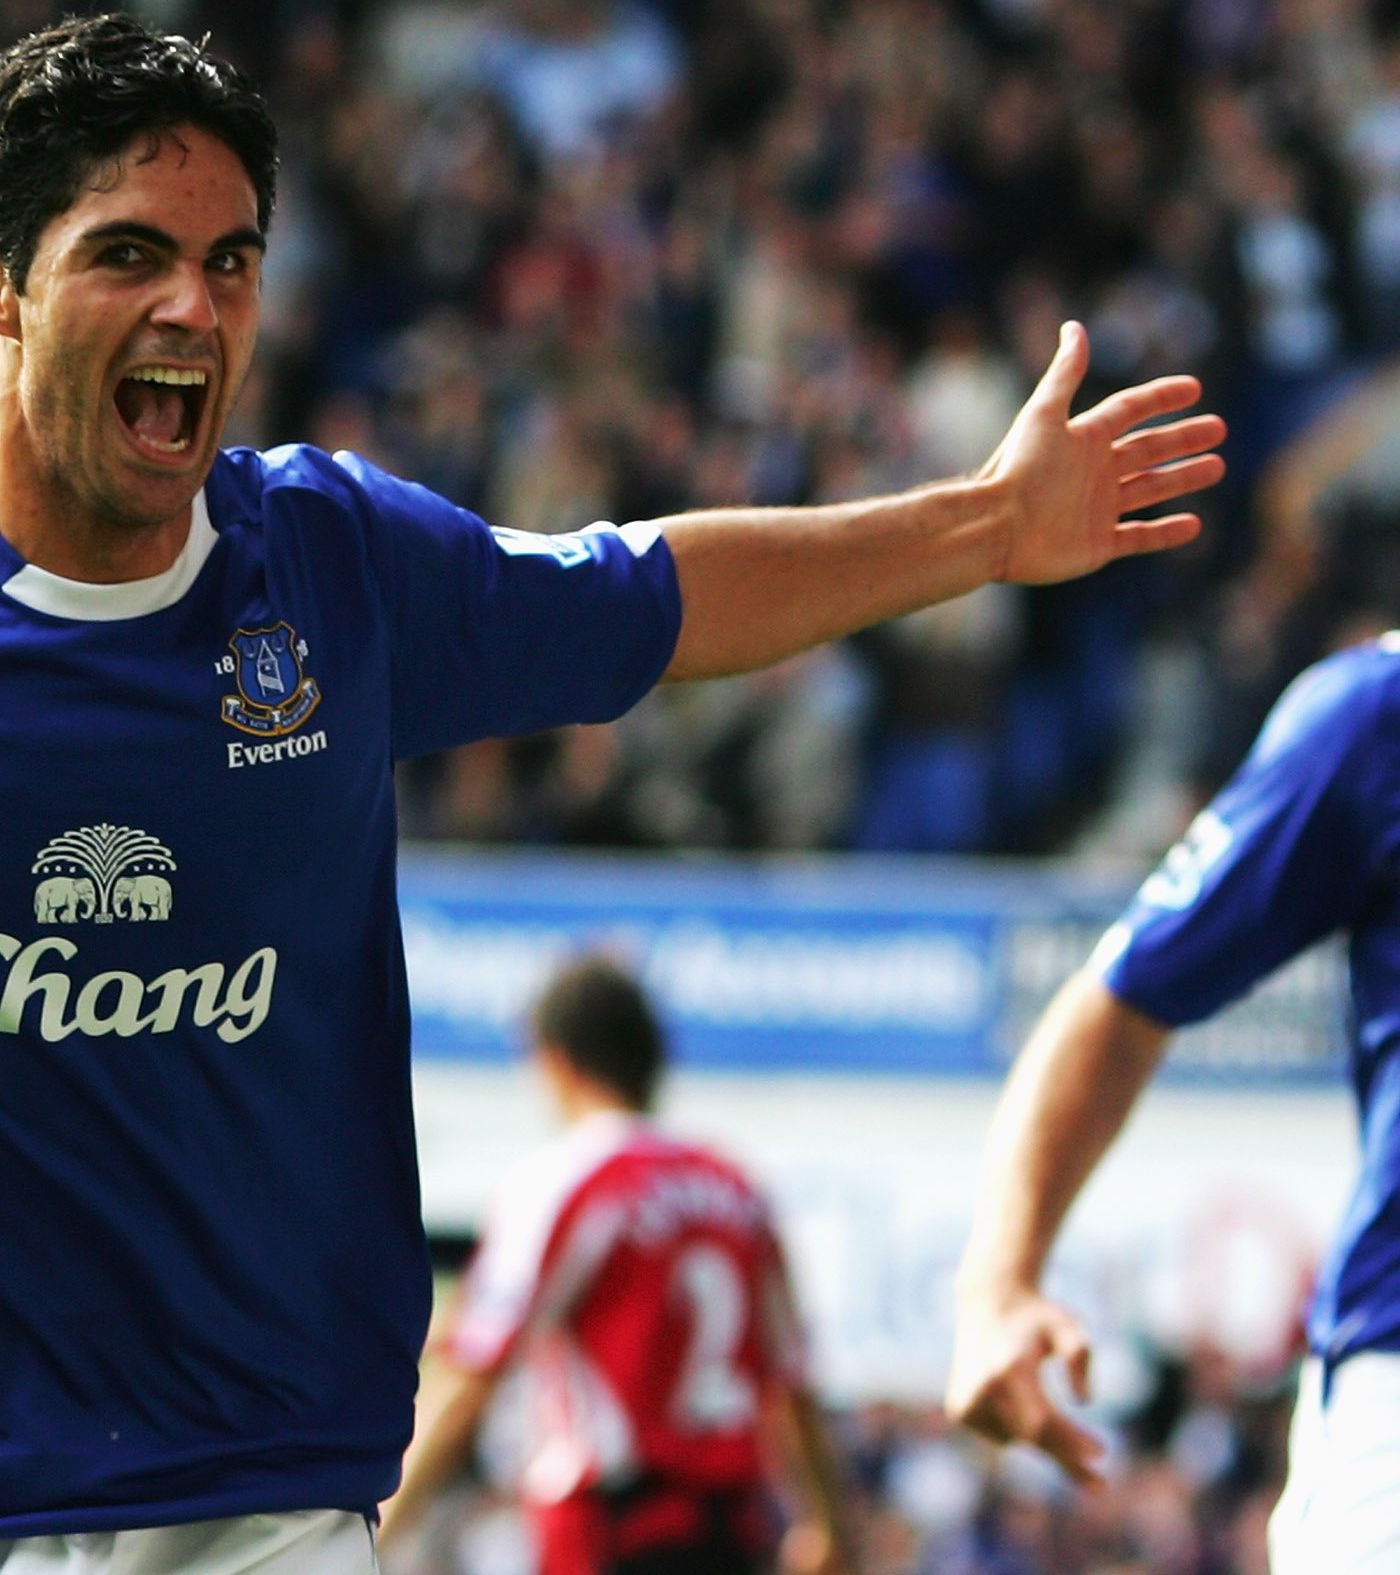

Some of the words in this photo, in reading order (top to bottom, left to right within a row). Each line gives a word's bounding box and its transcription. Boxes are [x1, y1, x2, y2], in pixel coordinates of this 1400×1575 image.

[213, 655, 235, 675] 18
[226, 730, 328, 768] Everton
[670, 1246, 760, 1430] 2
